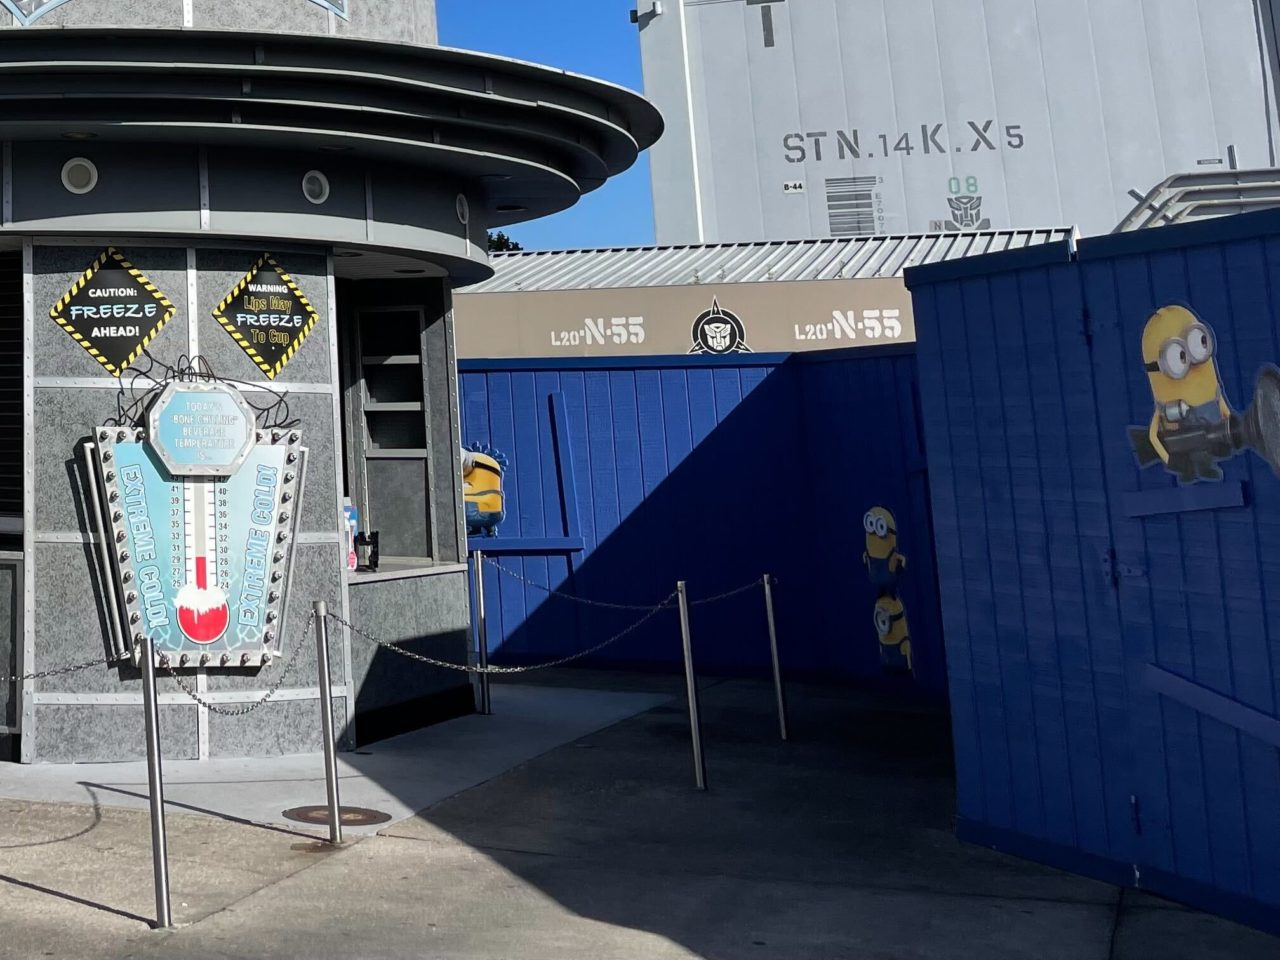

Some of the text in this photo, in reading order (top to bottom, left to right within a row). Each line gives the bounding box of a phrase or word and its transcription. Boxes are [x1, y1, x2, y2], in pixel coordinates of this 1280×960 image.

[88, 287, 138, 298] CAUTION:
[248, 284, 288, 294] WARNING
[70, 303, 157, 320] FREEZE
[243, 295, 268, 313] Lips
[236, 313, 303, 327] FREEZE
[91, 326, 140, 338] AHEAD!
[251, 328, 290, 347] To Cup
[120, 464, 170, 628] EXTREME COLD!
[238, 464, 278, 627] EXTREME COLD!
